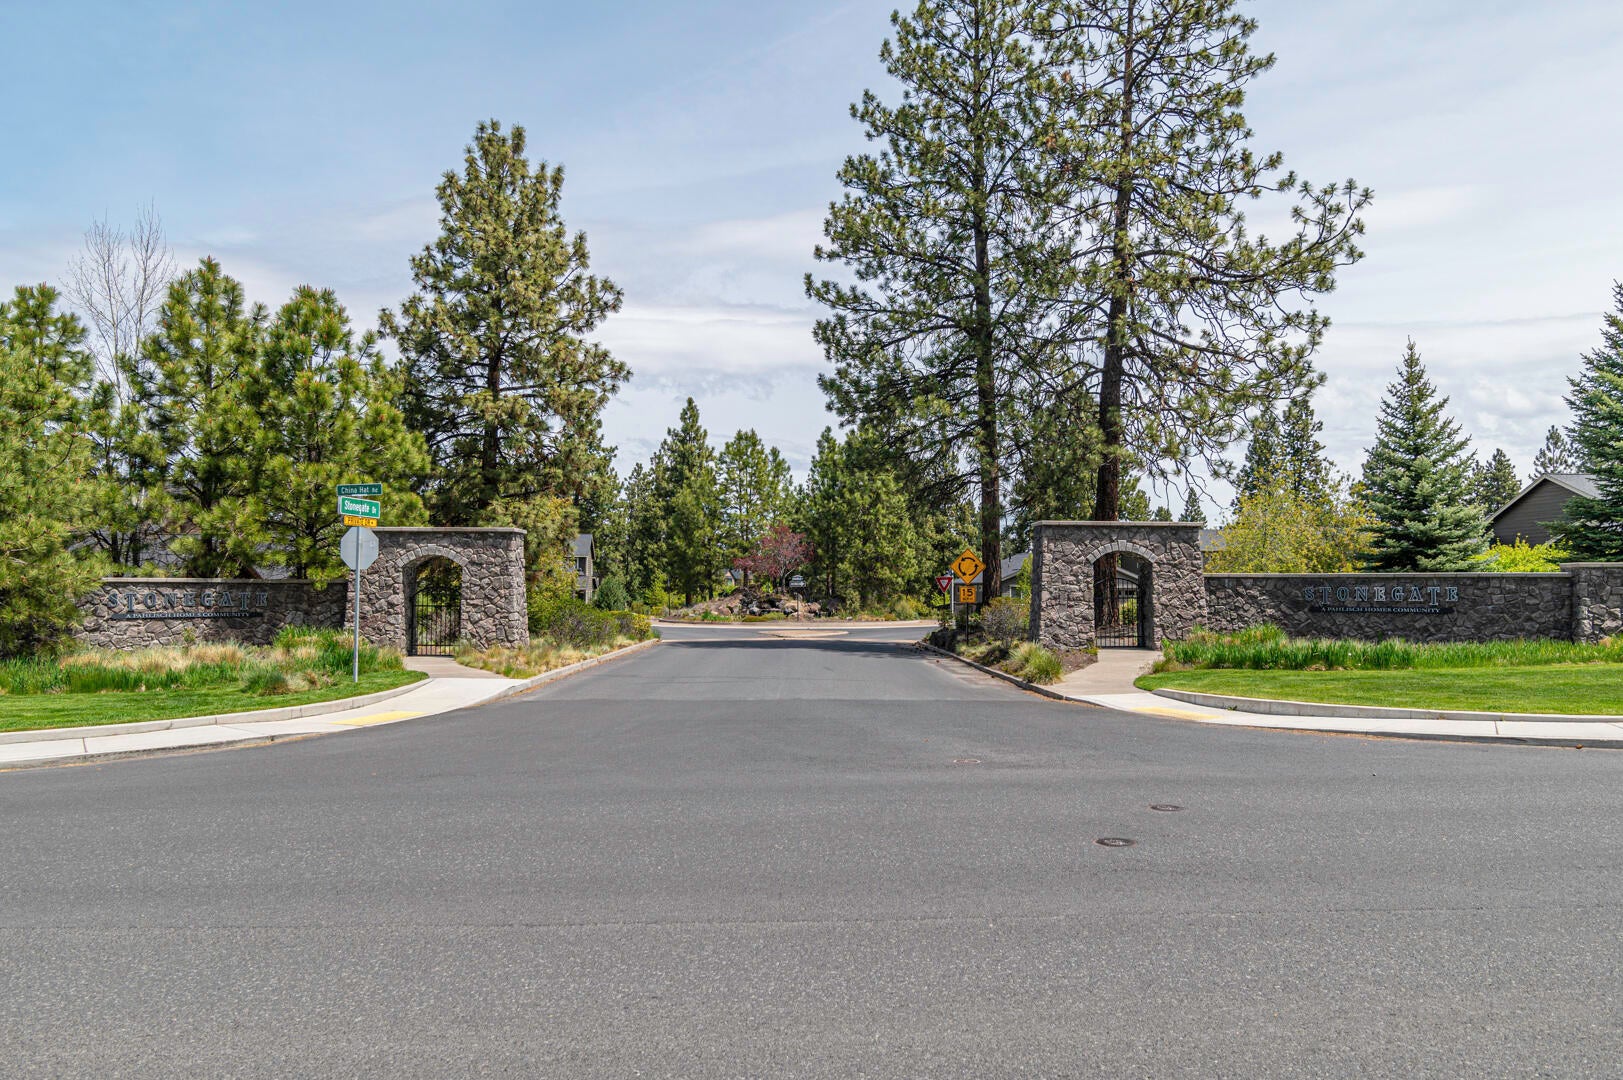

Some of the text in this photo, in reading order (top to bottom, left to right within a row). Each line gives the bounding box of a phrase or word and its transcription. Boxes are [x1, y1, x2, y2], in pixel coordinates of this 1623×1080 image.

[344, 500, 370, 514] Stonegate
[962, 588, 974, 597] 15
[1304, 586, 1459, 605] STONEGATE
[107, 592, 268, 611] STONEGATE
